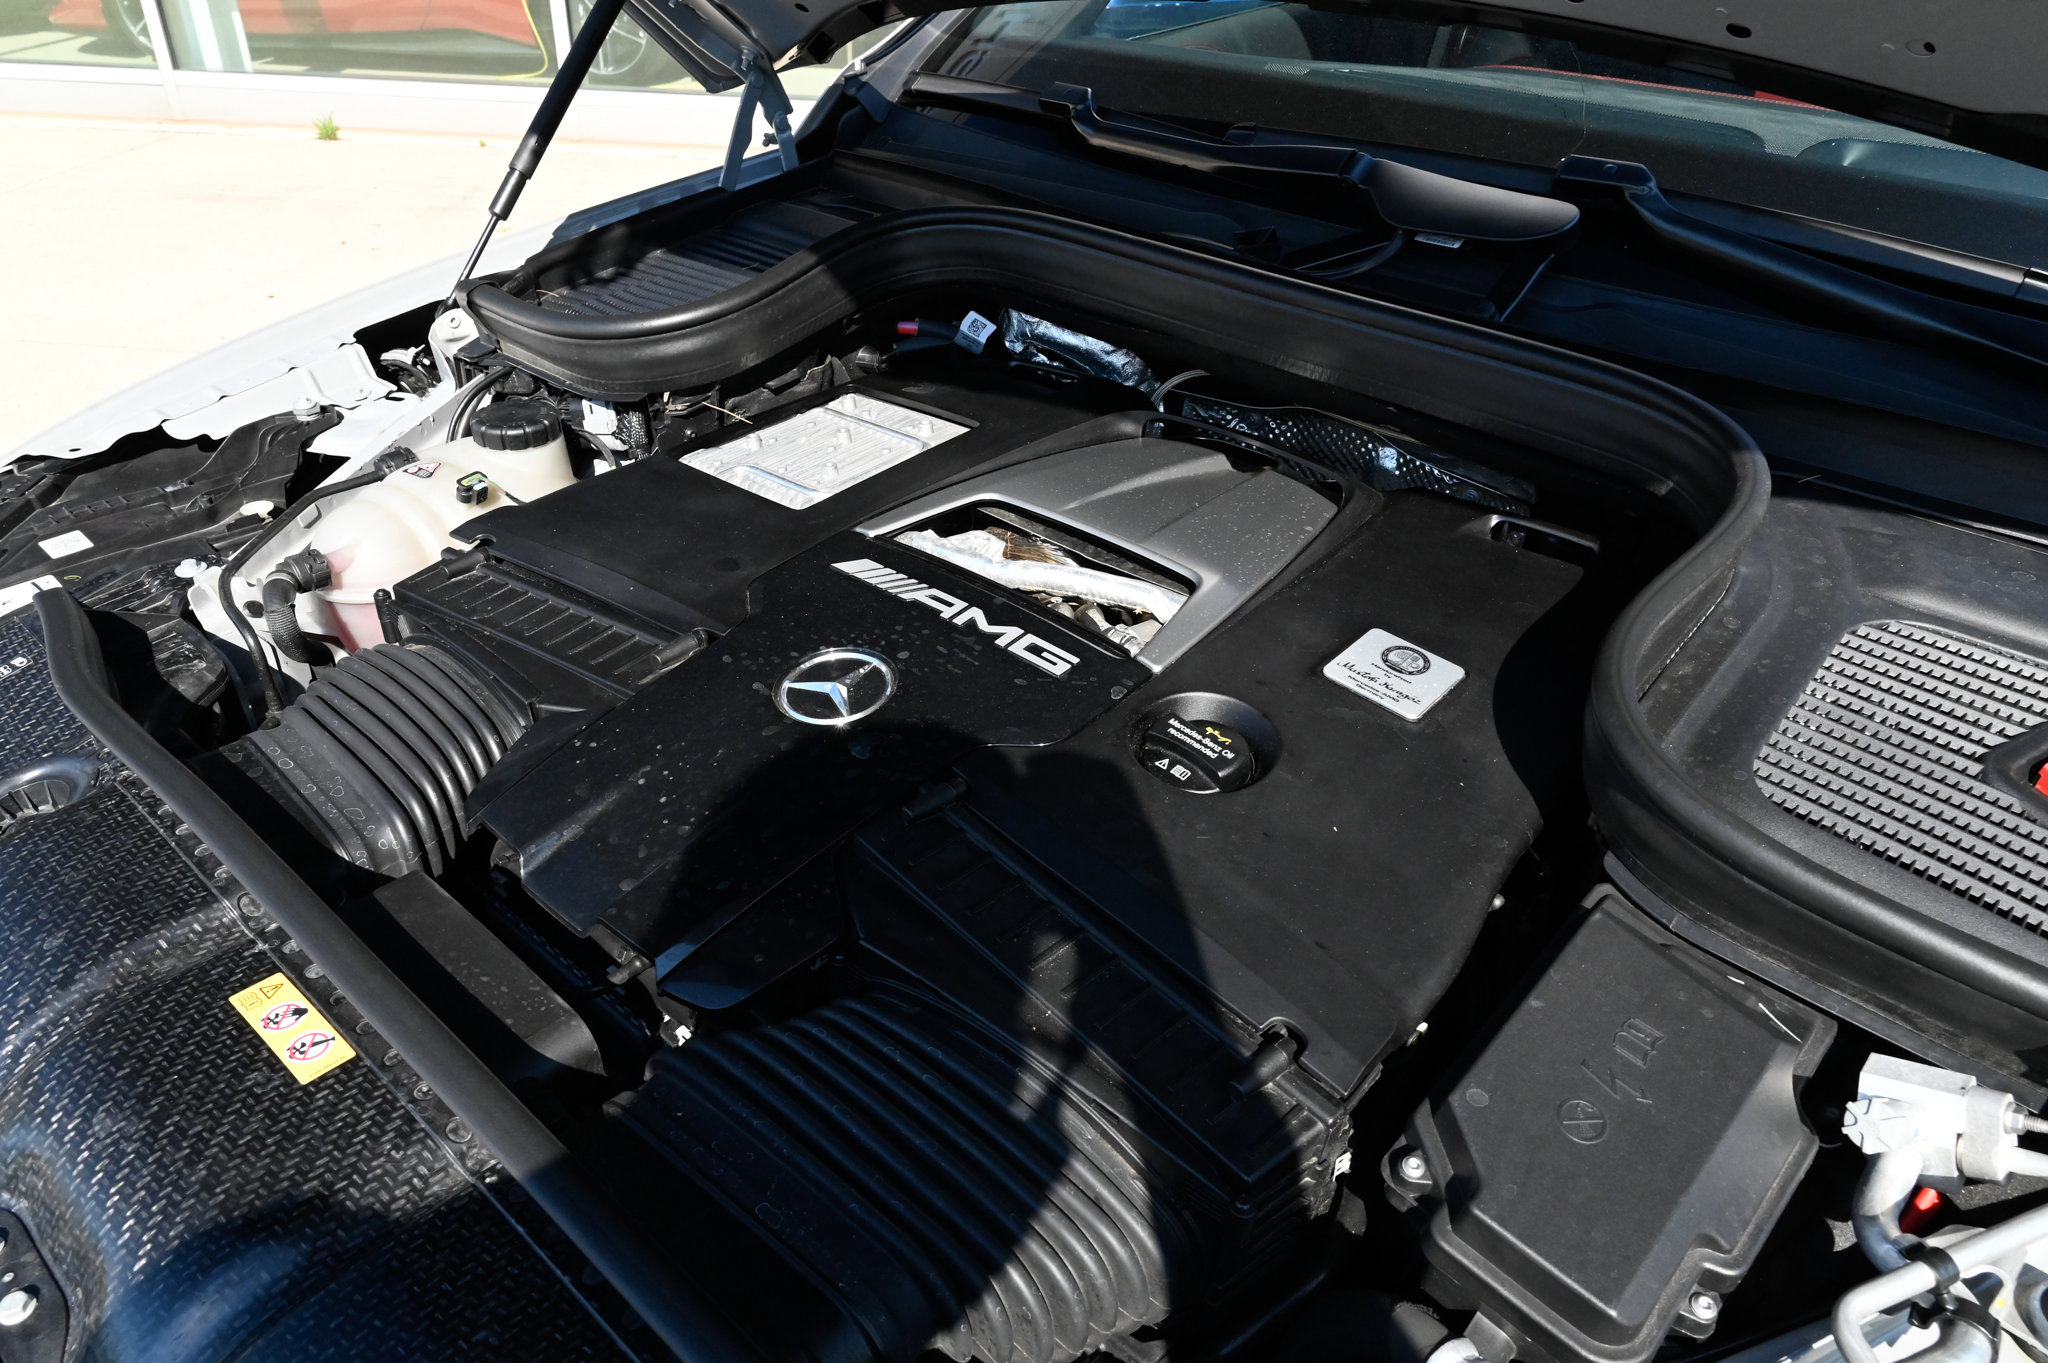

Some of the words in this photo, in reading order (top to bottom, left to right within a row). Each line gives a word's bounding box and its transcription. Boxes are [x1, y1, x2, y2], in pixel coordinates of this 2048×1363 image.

[897, 588, 1081, 678] AMG
[1347, 675, 1400, 703] Mercedes-AMG
[1355, 683, 1385, 700] Germany
[1167, 727, 1219, 759] recommended
[1168, 718, 1222, 752] Mercedes-Benz
[1221, 749, 1235, 759] Oil
